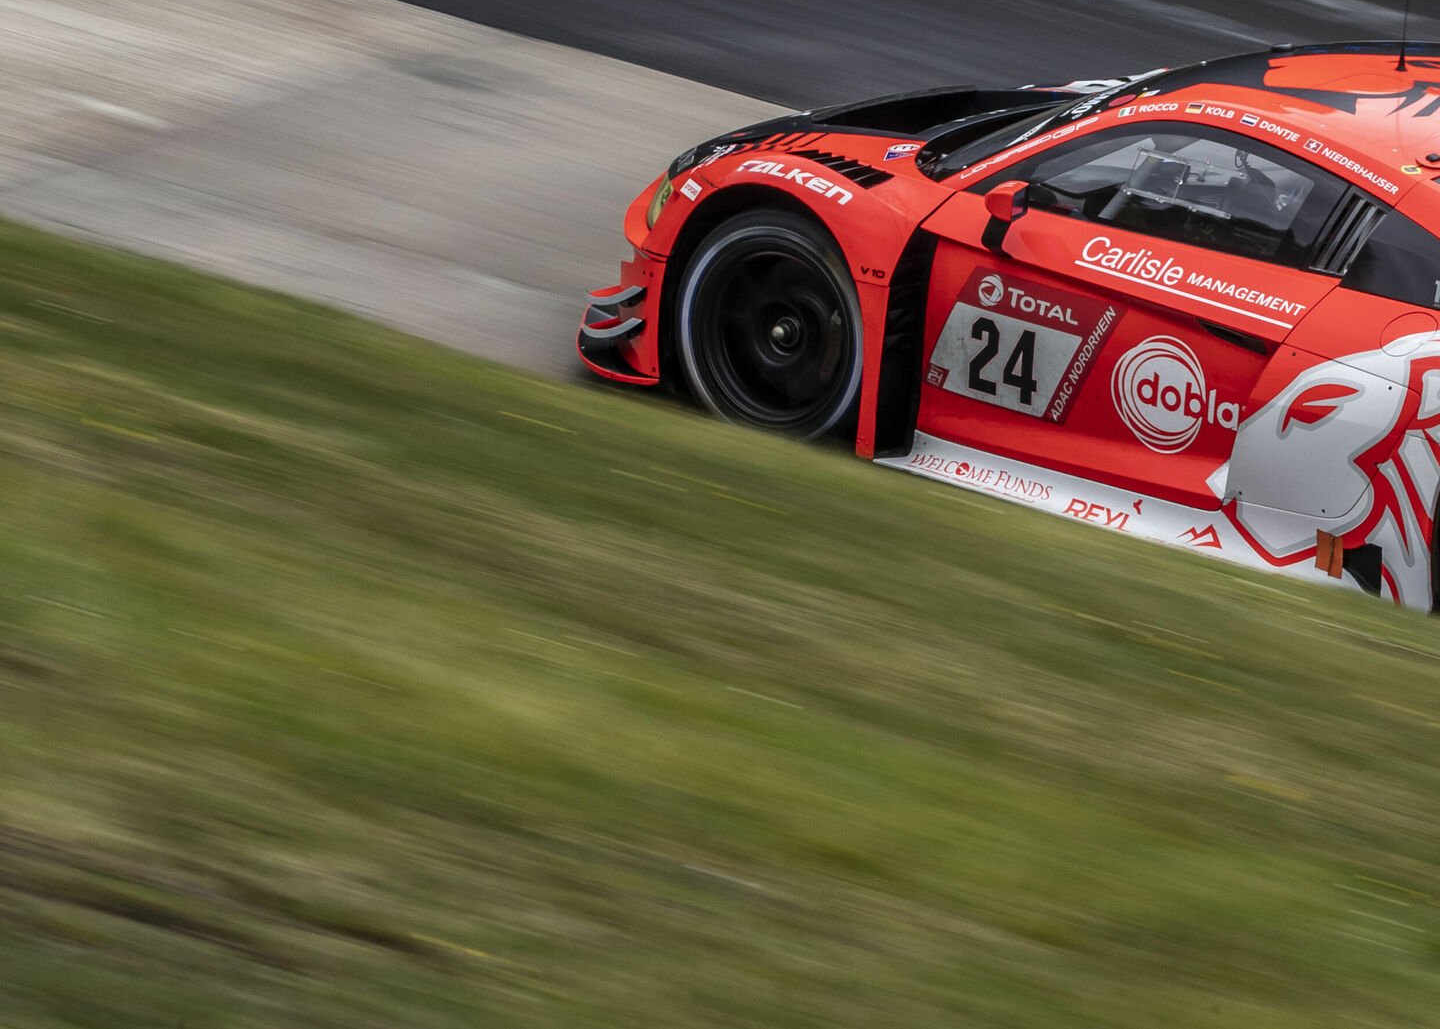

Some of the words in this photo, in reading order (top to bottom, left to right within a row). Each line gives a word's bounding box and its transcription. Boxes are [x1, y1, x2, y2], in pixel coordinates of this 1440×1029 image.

[1138, 102, 1179, 113] ROCCO
[1204, 106, 1235, 119] KOLB
[1258, 120, 1301, 143] DONTJE
[736, 160, 854, 206] FALKEN
[1320, 146, 1400, 196] NIEDERHAUSER
[1081, 236, 1184, 286] Carlisle
[1185, 271, 1306, 317] MANAGEMENT
[1007, 287, 1078, 326] TOTAL
[967, 316, 1039, 407] 24
[1051, 384, 1074, 422] ADAC
[1069, 305, 1117, 386] NORDRHEIN
[1136, 371, 1240, 431] dobla
[910, 453, 995, 485] WELCOME
[995, 469, 1054, 501] FUNDS
[1061, 497, 1130, 533] REYL
